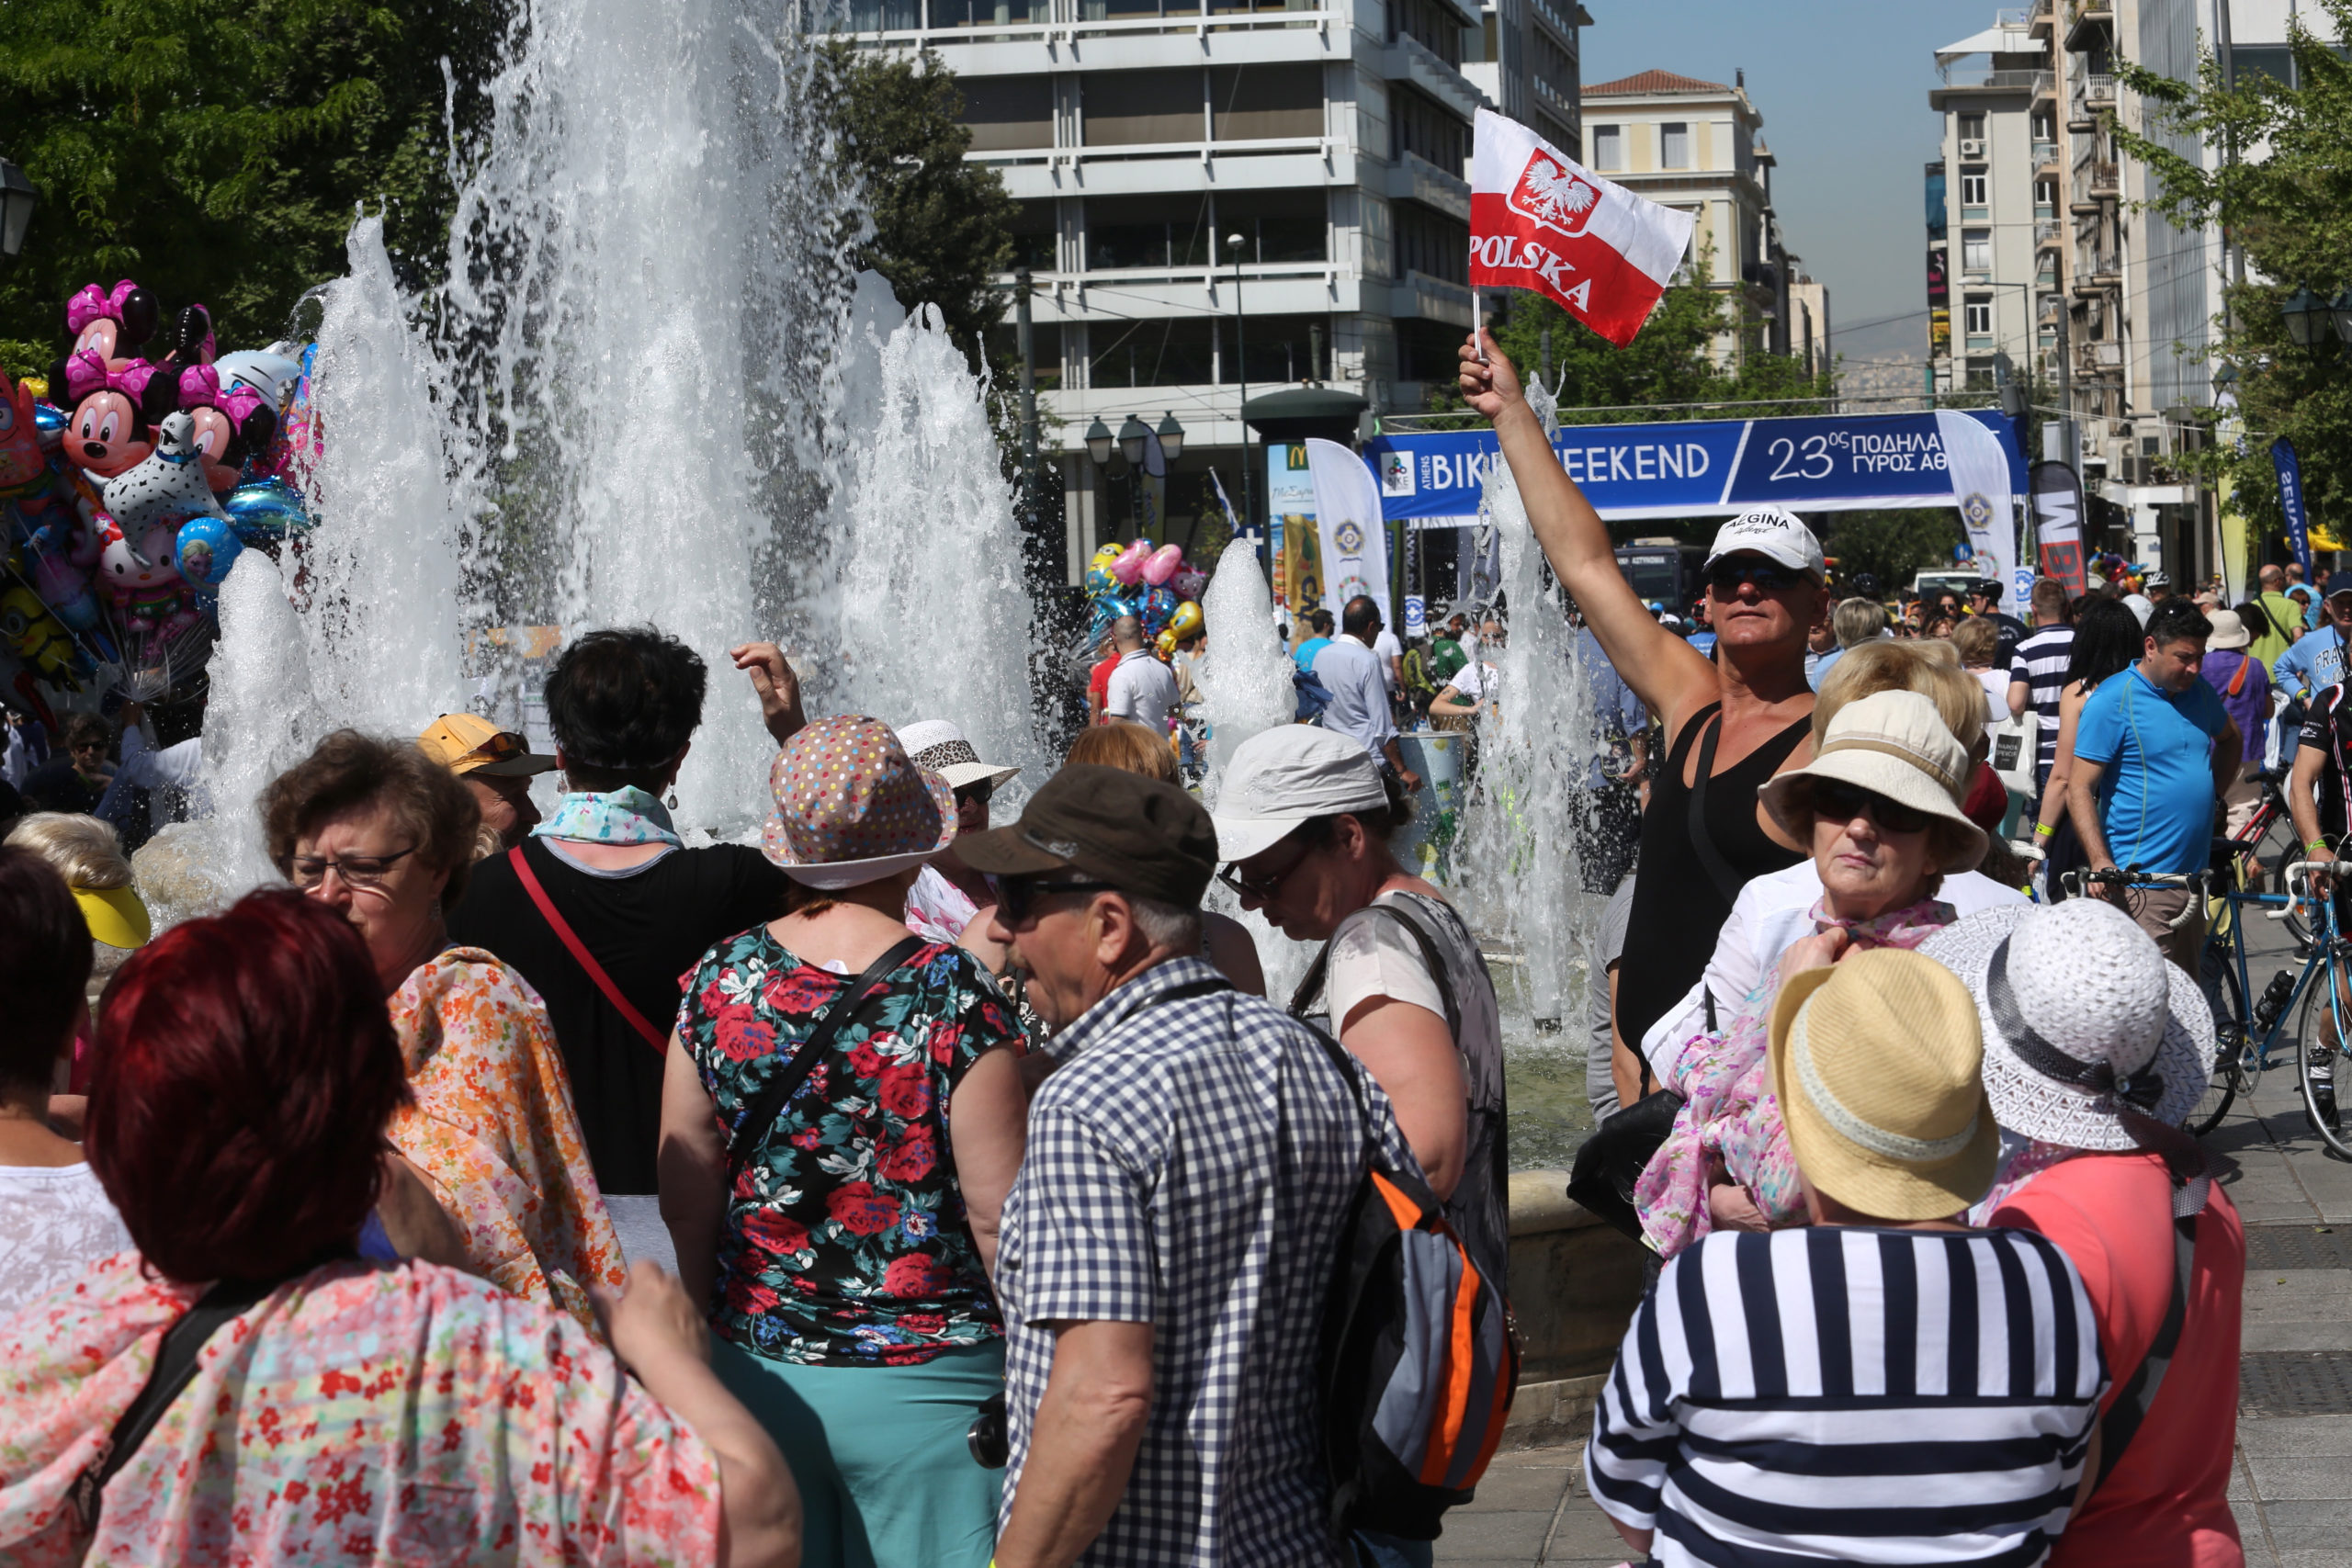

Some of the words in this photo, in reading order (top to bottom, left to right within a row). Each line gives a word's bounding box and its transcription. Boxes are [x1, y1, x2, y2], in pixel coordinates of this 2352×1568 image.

[1469, 235, 1592, 313] POLSKA
[1851, 433, 1944, 454] ΠΟΔΗΛΑ
[1420, 455, 1432, 491] ATHENS
[1553, 443, 1710, 483] EEKEND
[1852, 455, 1916, 473] ΓΥΡΟΣ
[1920, 453, 1948, 471] ΑΘ
[1725, 513, 1790, 530] AEGINA
